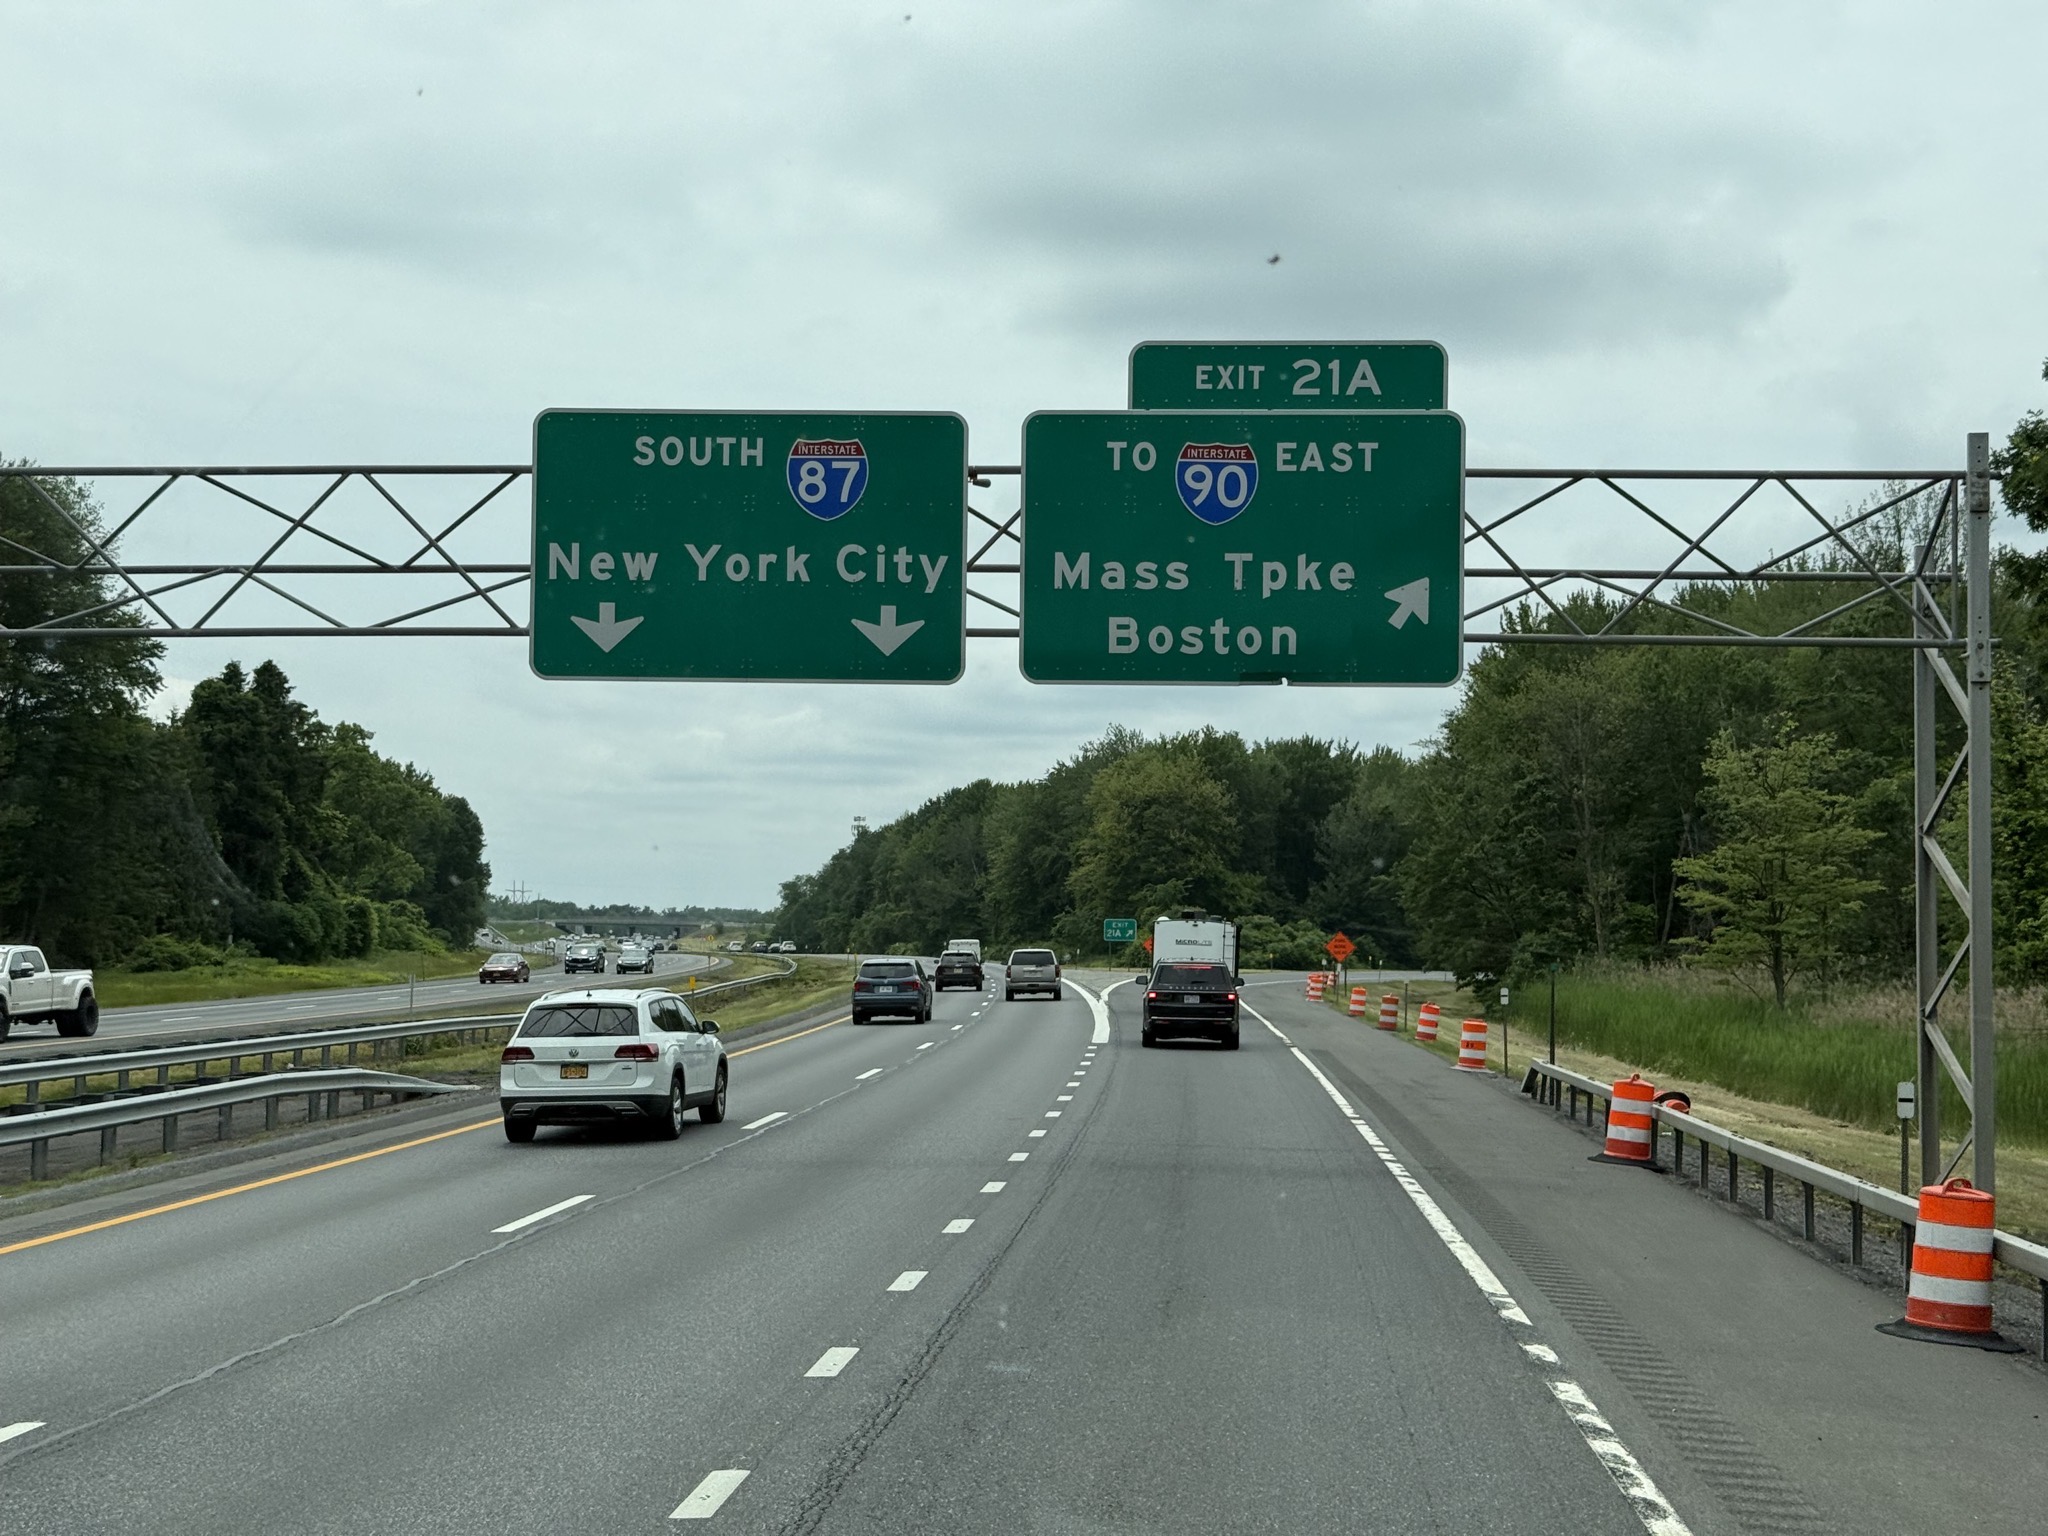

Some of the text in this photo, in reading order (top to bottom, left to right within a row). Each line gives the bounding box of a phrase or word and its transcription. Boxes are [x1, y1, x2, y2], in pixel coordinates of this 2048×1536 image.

[1196, 359, 1382, 396] EXIT 21A
[634, 436, 763, 467] SOUTH
[798, 445, 857, 455] INTERSTATE
[1106, 441, 1157, 472] TO
[1187, 448, 1247, 459] INTERSTATE
[1276, 442, 1379, 472] EAST
[798, 461, 860, 504] 87
[1184, 465, 1248, 508] 90
[549, 542, 948, 593] New York City
[1054, 551, 1355, 599] Mass Tpke
[1108, 616, 1296, 655] Boston
[1107, 929, 1121, 937] 21A
